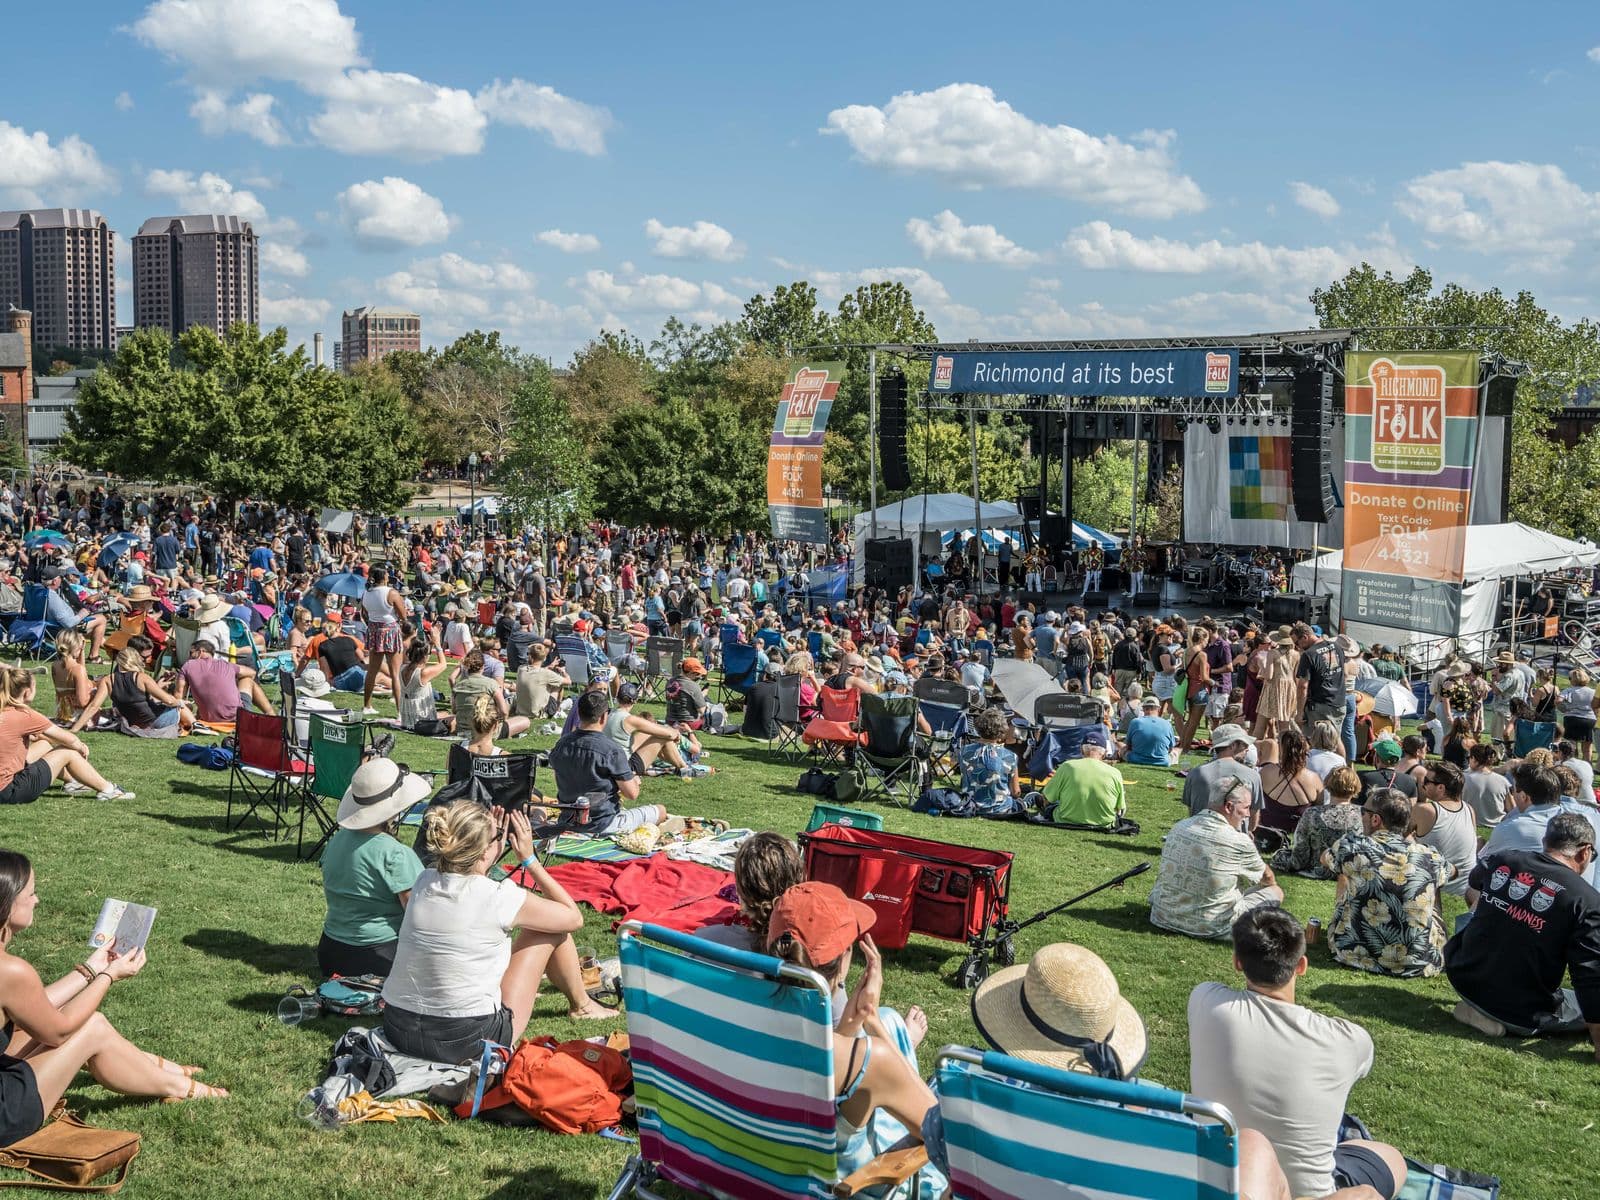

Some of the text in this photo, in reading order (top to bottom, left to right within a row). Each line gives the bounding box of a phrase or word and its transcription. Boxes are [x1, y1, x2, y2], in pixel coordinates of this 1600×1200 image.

[973, 361, 1175, 385] Richmond at its best
[1207, 367, 1227, 381] FOLK
[1380, 377, 1438, 397] RICHMOND
[789, 393, 818, 417] FOLK
[1378, 404, 1438, 441] FOLK
[796, 452, 818, 462] Online
[1382, 445, 1433, 456] FESTIVAL
[782, 471, 803, 482] FOLK
[782, 487, 804, 498] 44321
[1350, 491, 1465, 513] Donate Online
[1377, 513, 1432, 526] Text Code:
[1379, 523, 1430, 542] FOLK
[1377, 548, 1430, 565] 44321
[1369, 589, 1404, 600] Richmond
[1480, 891, 1510, 911] PURE
[1505, 904, 1547, 930] MADNESS
